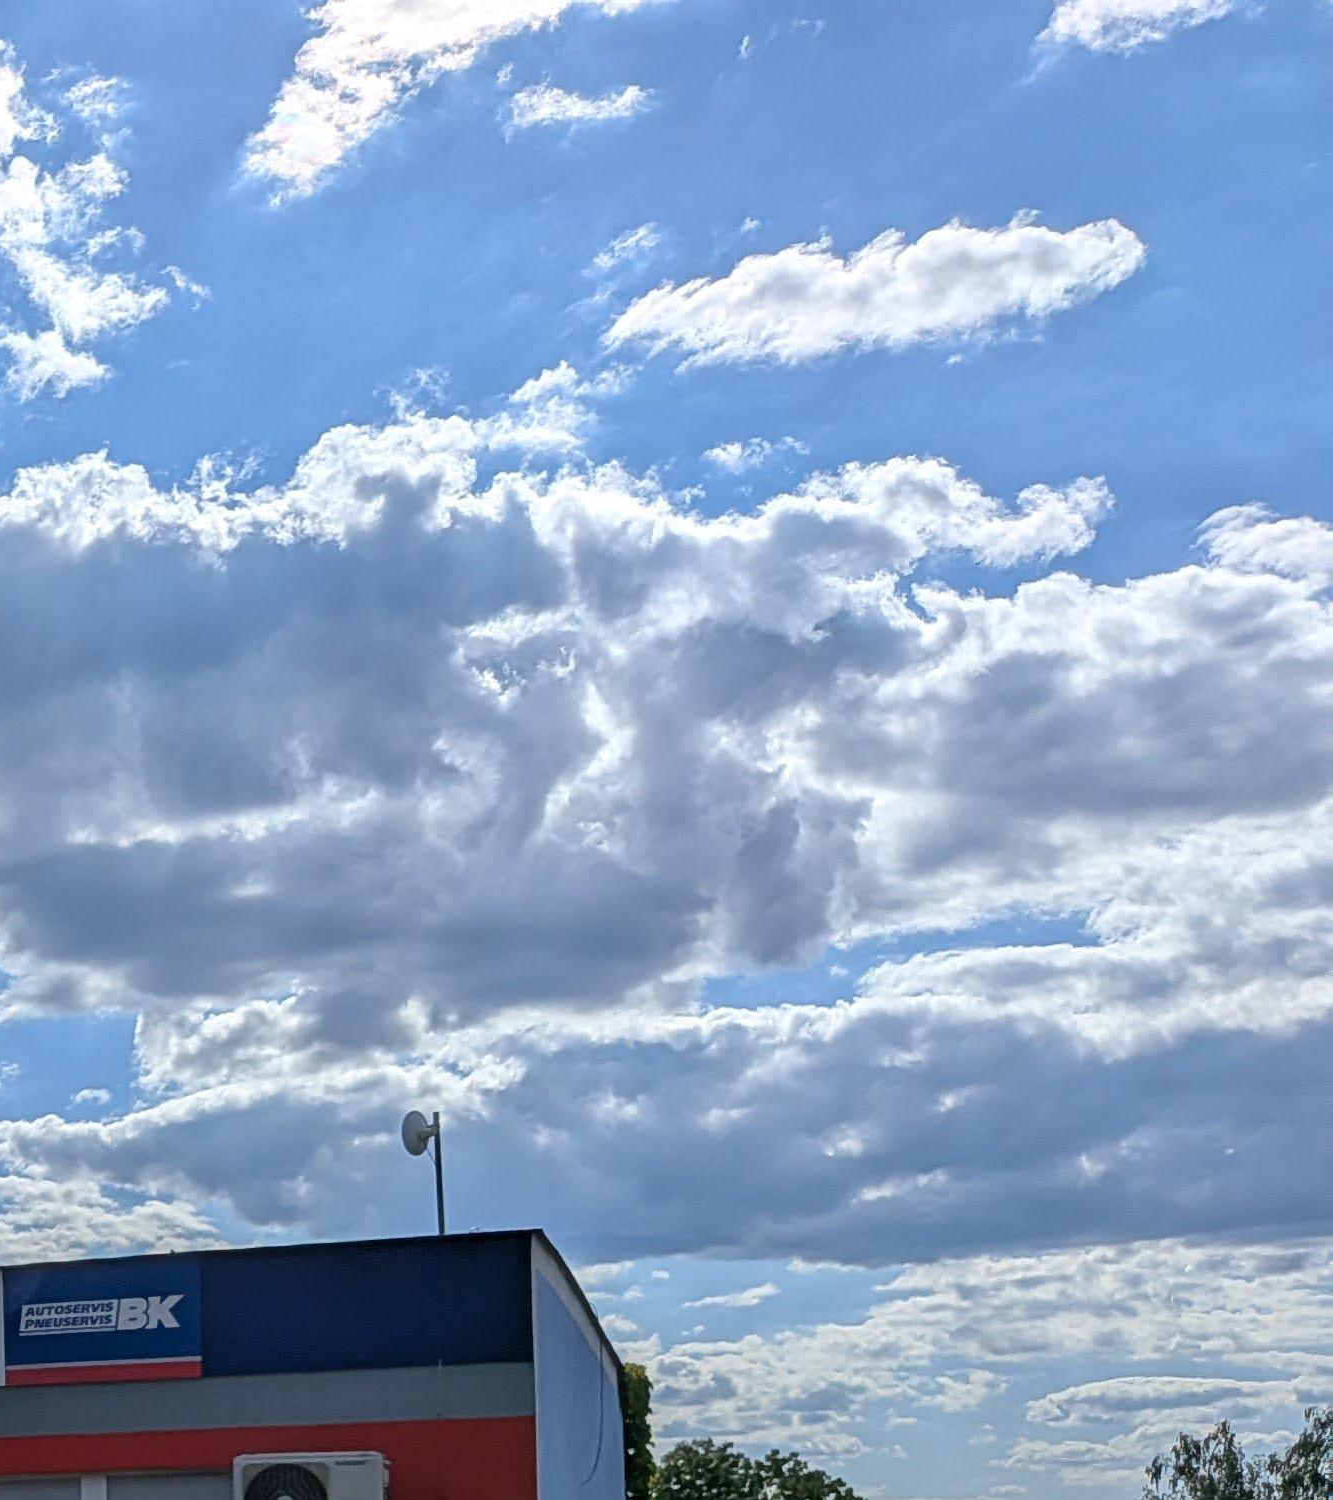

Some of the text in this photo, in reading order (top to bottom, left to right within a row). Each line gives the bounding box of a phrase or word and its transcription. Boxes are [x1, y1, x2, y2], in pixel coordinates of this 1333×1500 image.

[25, 1302, 114, 1316] AUTOSERVIS
[116, 1294, 184, 1330] BK
[24, 1314, 112, 1329] PNEUSERVIS
